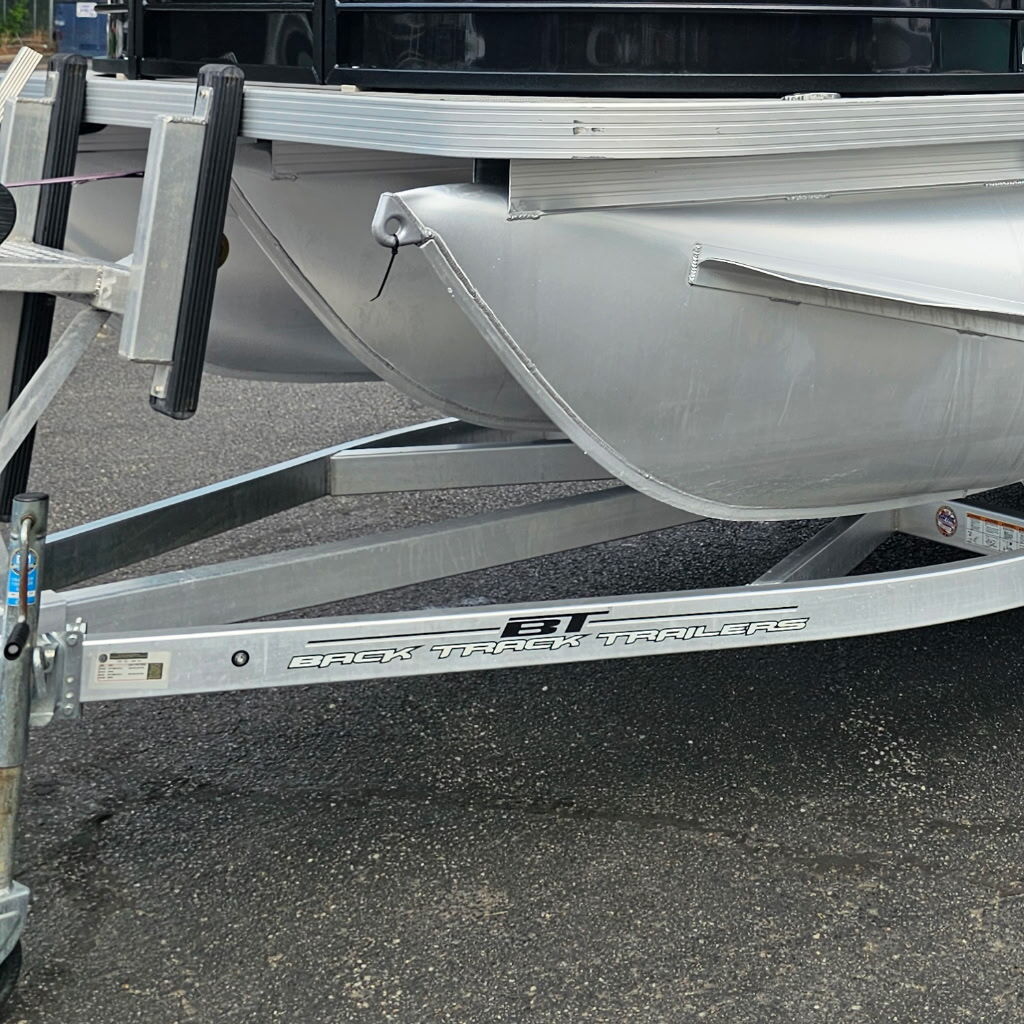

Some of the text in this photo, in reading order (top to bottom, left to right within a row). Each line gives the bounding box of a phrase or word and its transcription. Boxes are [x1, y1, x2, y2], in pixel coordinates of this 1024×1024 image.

[287, 617, 810, 669] BACK TRACK TRAILERS
[500, 610, 609, 638] BT
